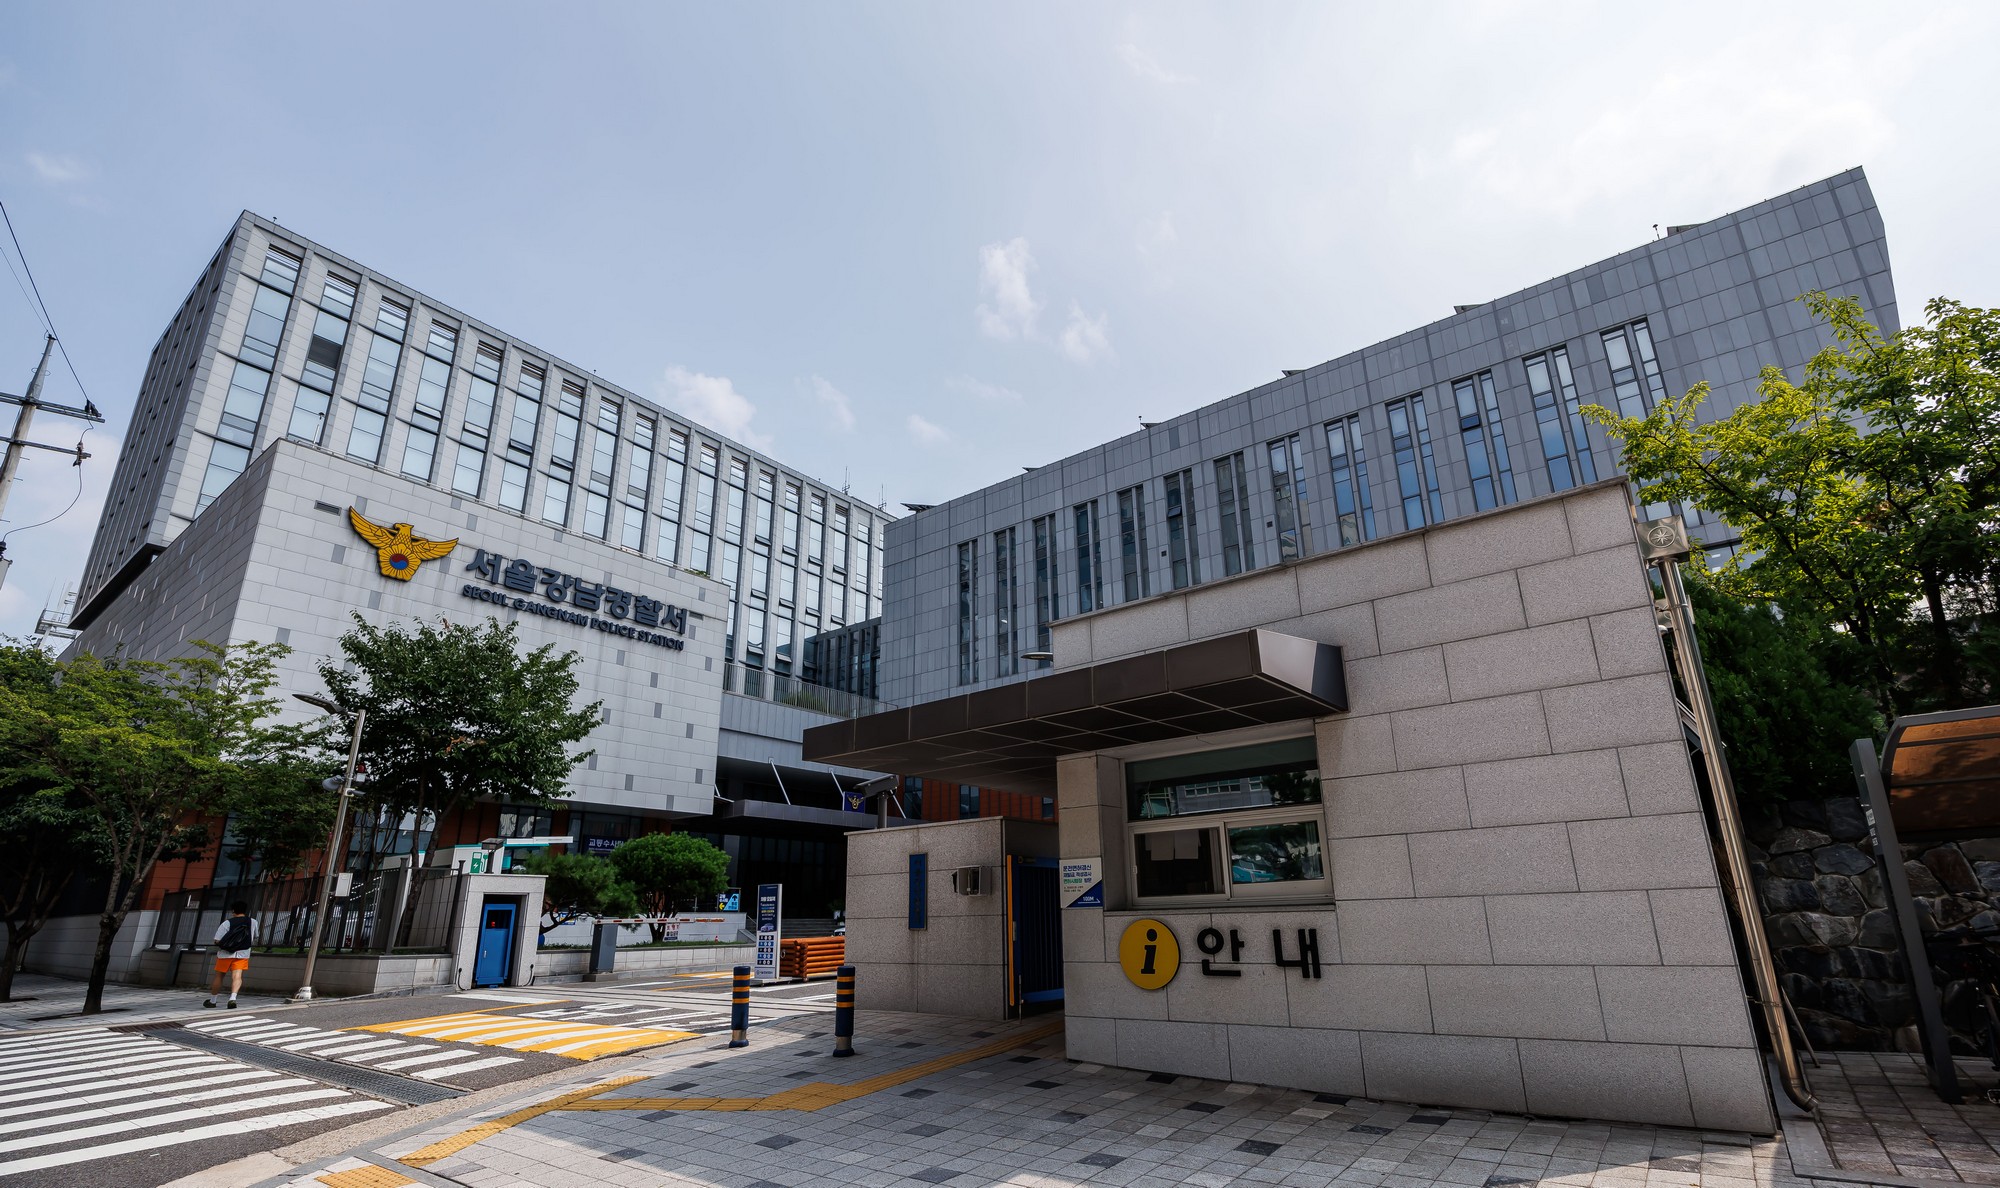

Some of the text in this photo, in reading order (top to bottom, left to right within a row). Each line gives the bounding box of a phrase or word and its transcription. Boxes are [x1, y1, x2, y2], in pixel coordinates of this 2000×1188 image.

[462, 584, 684, 651] SEOUL GANGNAM POLICE STATION
[465, 549, 688, 634] 서울강남경찰서
[1141, 928, 1157, 974] i
